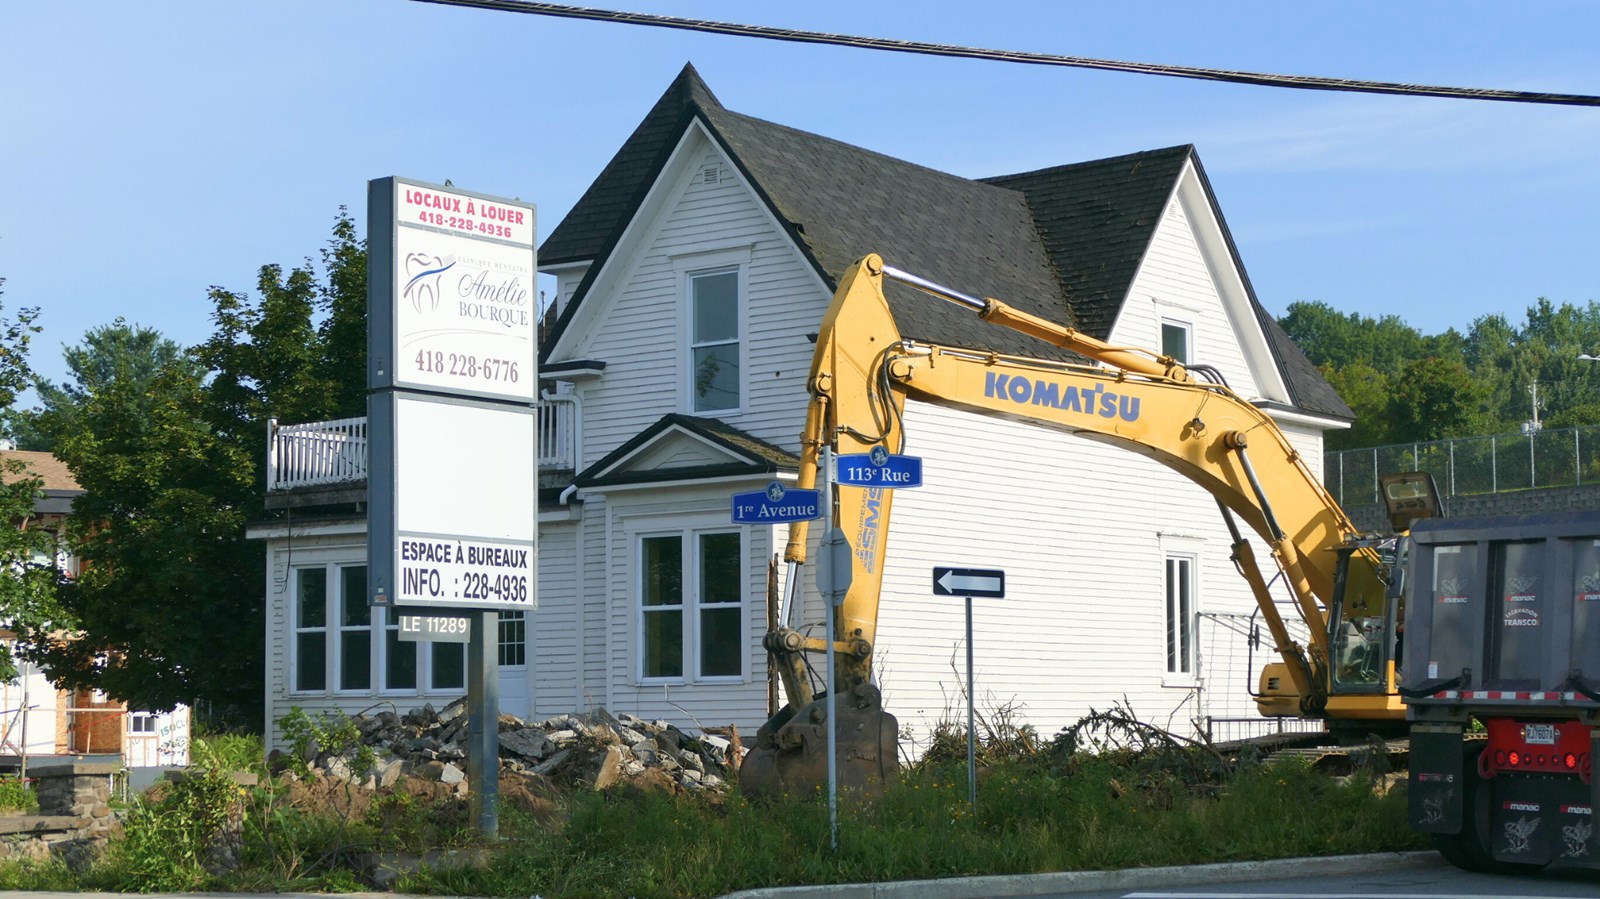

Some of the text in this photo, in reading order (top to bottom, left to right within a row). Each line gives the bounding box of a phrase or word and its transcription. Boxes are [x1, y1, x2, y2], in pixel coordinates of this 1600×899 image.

[406, 190, 524, 225] LOCAUX À LOUER
[419, 211, 512, 238] 418-228-4936
[458, 270, 528, 307] Amélie
[459, 301, 529, 328] BOURQUE
[415, 349, 519, 383] 418 228-6776
[984, 371, 1141, 422] KOMATSU
[847, 466, 911, 482] 113e Rue
[736, 503, 816, 519] 1re Avenue
[402, 540, 528, 569] ESPACE À BUREAUX
[403, 567, 445, 597] INFO.
[463, 572, 527, 603] 228-4936
[402, 616, 467, 633] LE 11289
[1510, 803, 1540, 812] manac
